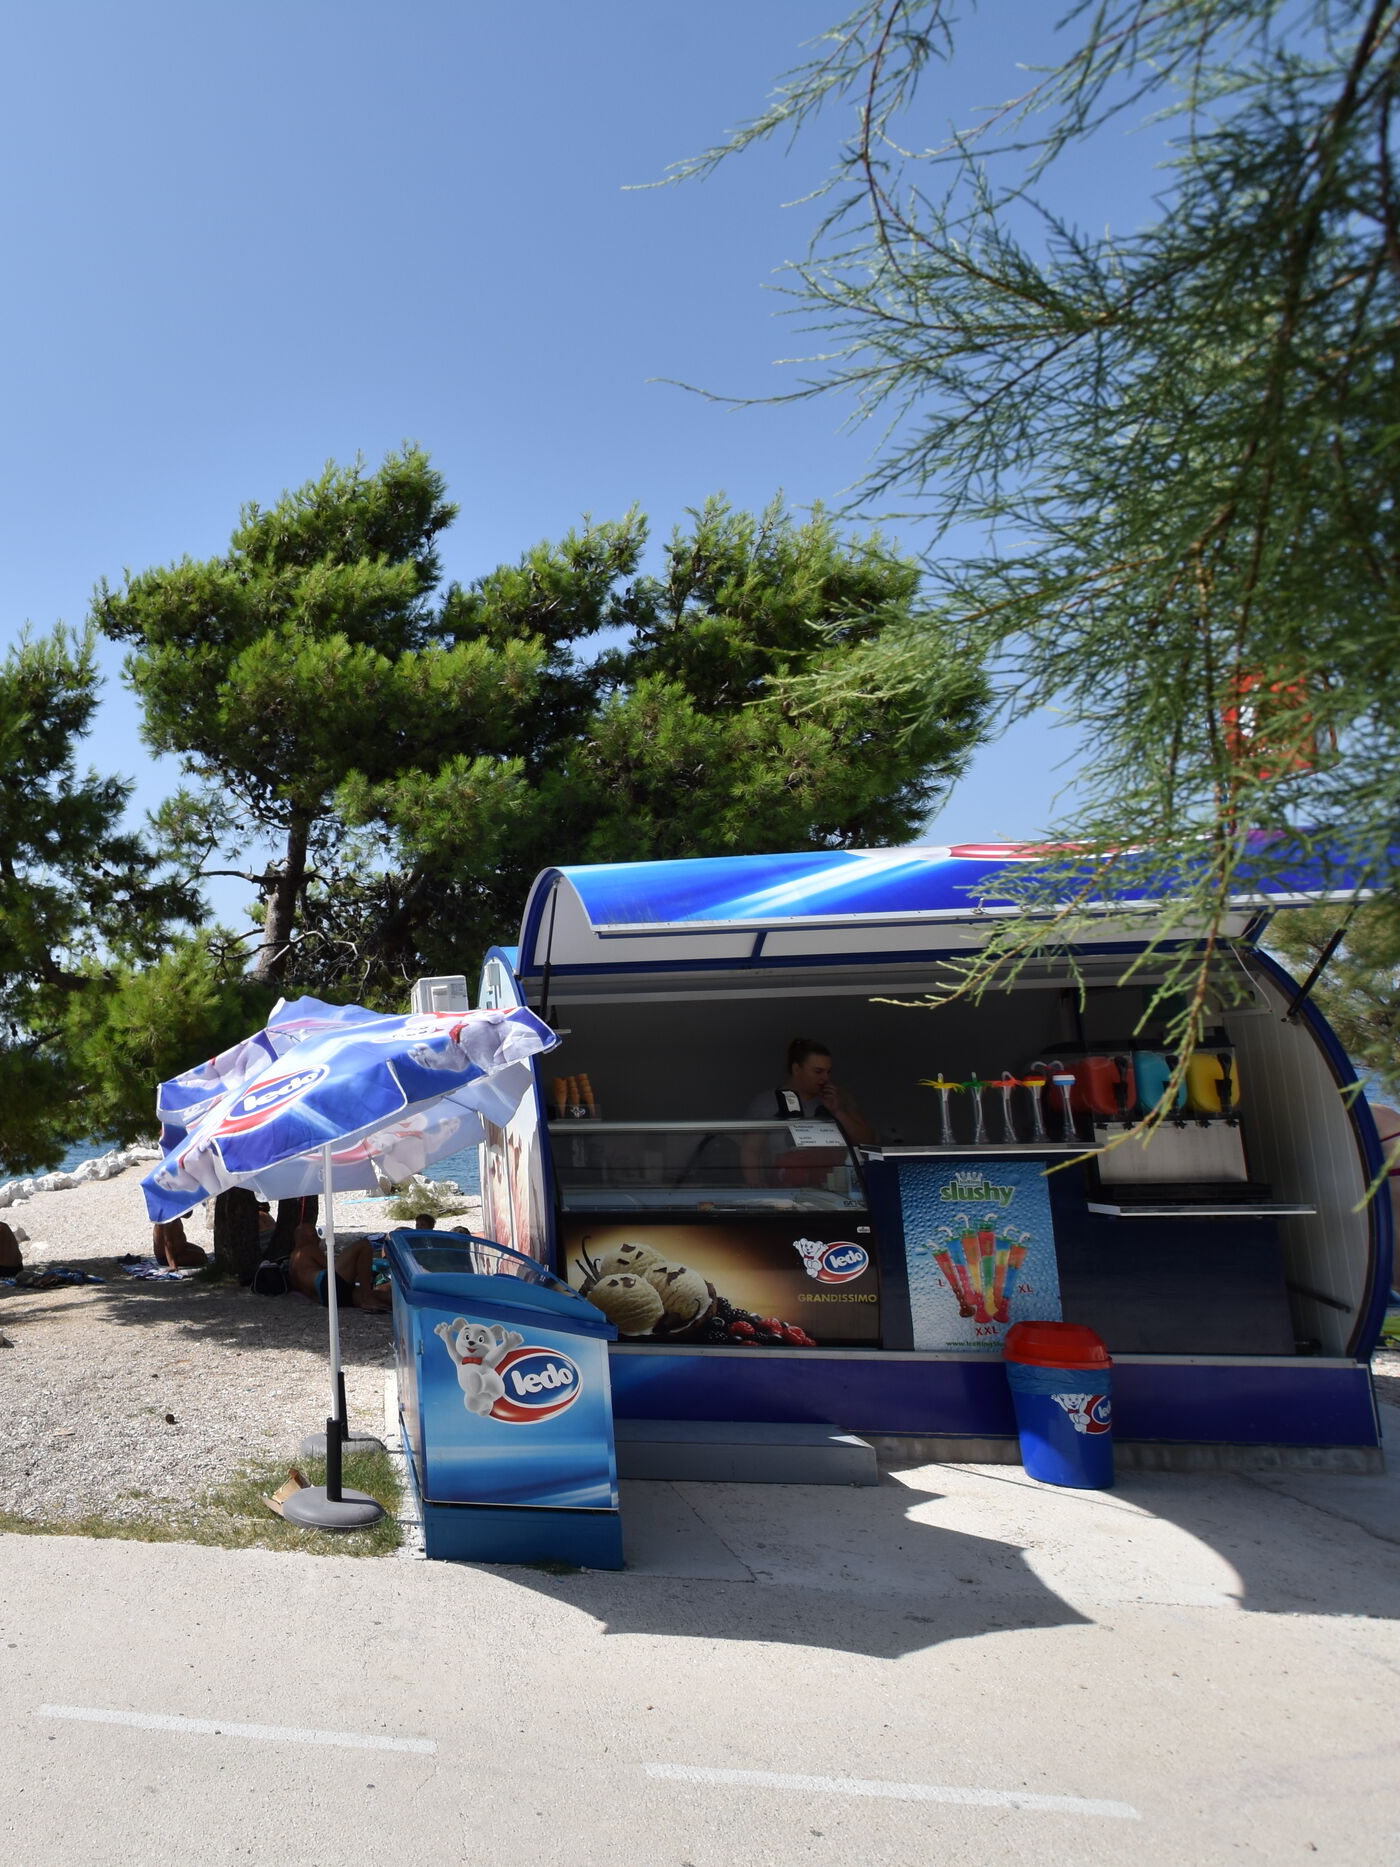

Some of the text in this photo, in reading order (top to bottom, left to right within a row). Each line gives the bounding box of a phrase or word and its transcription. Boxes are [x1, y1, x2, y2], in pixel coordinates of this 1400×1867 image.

[243, 1072, 319, 1111] ledo
[940, 1181, 1014, 1206] slushy
[829, 1250, 863, 1268] ledo
[1018, 1284, 1033, 1293] XL
[798, 1294, 877, 1303] GRANDISSIMO
[975, 1326, 999, 1336] XXL
[511, 1363, 573, 1396] ledo
[1098, 1400, 1112, 1419] led
